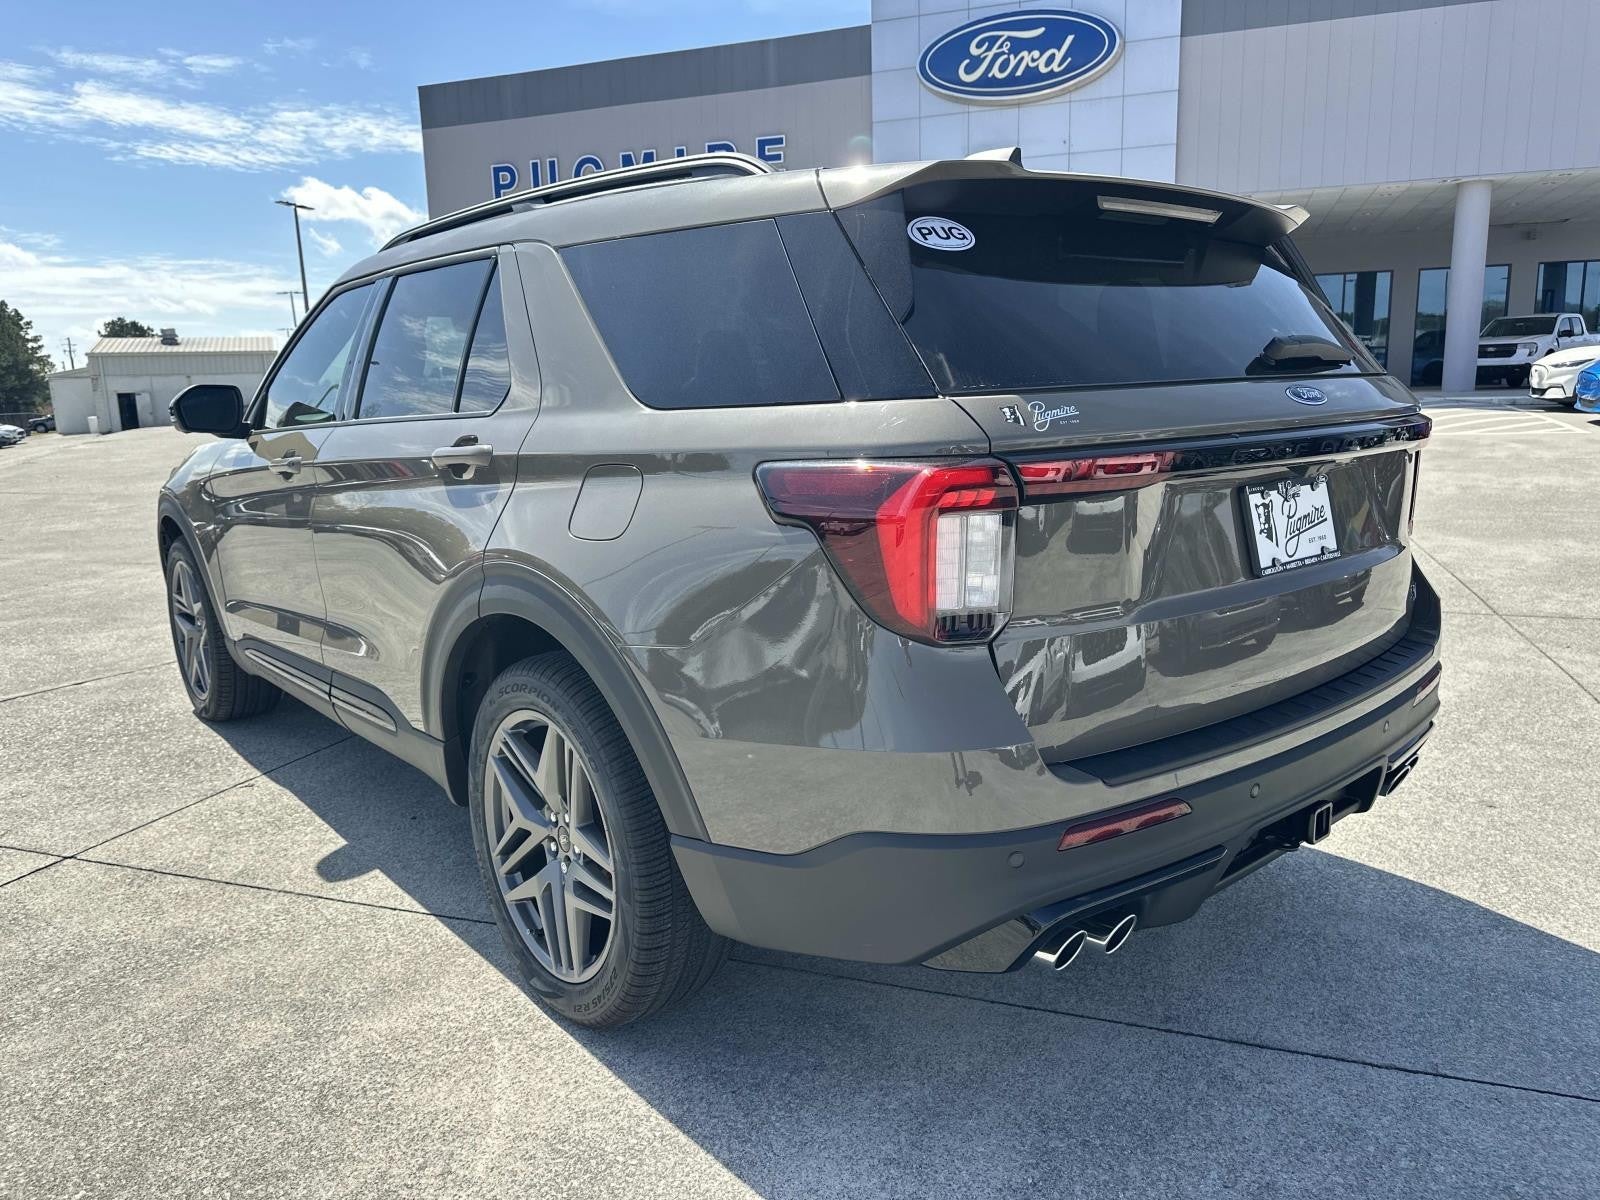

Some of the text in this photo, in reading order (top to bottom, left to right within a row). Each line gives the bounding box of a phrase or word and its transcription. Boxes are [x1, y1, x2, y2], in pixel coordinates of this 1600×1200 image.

[958, 27, 1075, 83] Ford
[915, 226, 969, 241] PUG
[1028, 400, 1080, 432] Pugmire
[1281, 498, 1328, 559] Pugmire
[498, 682, 560, 711] SCORPION
